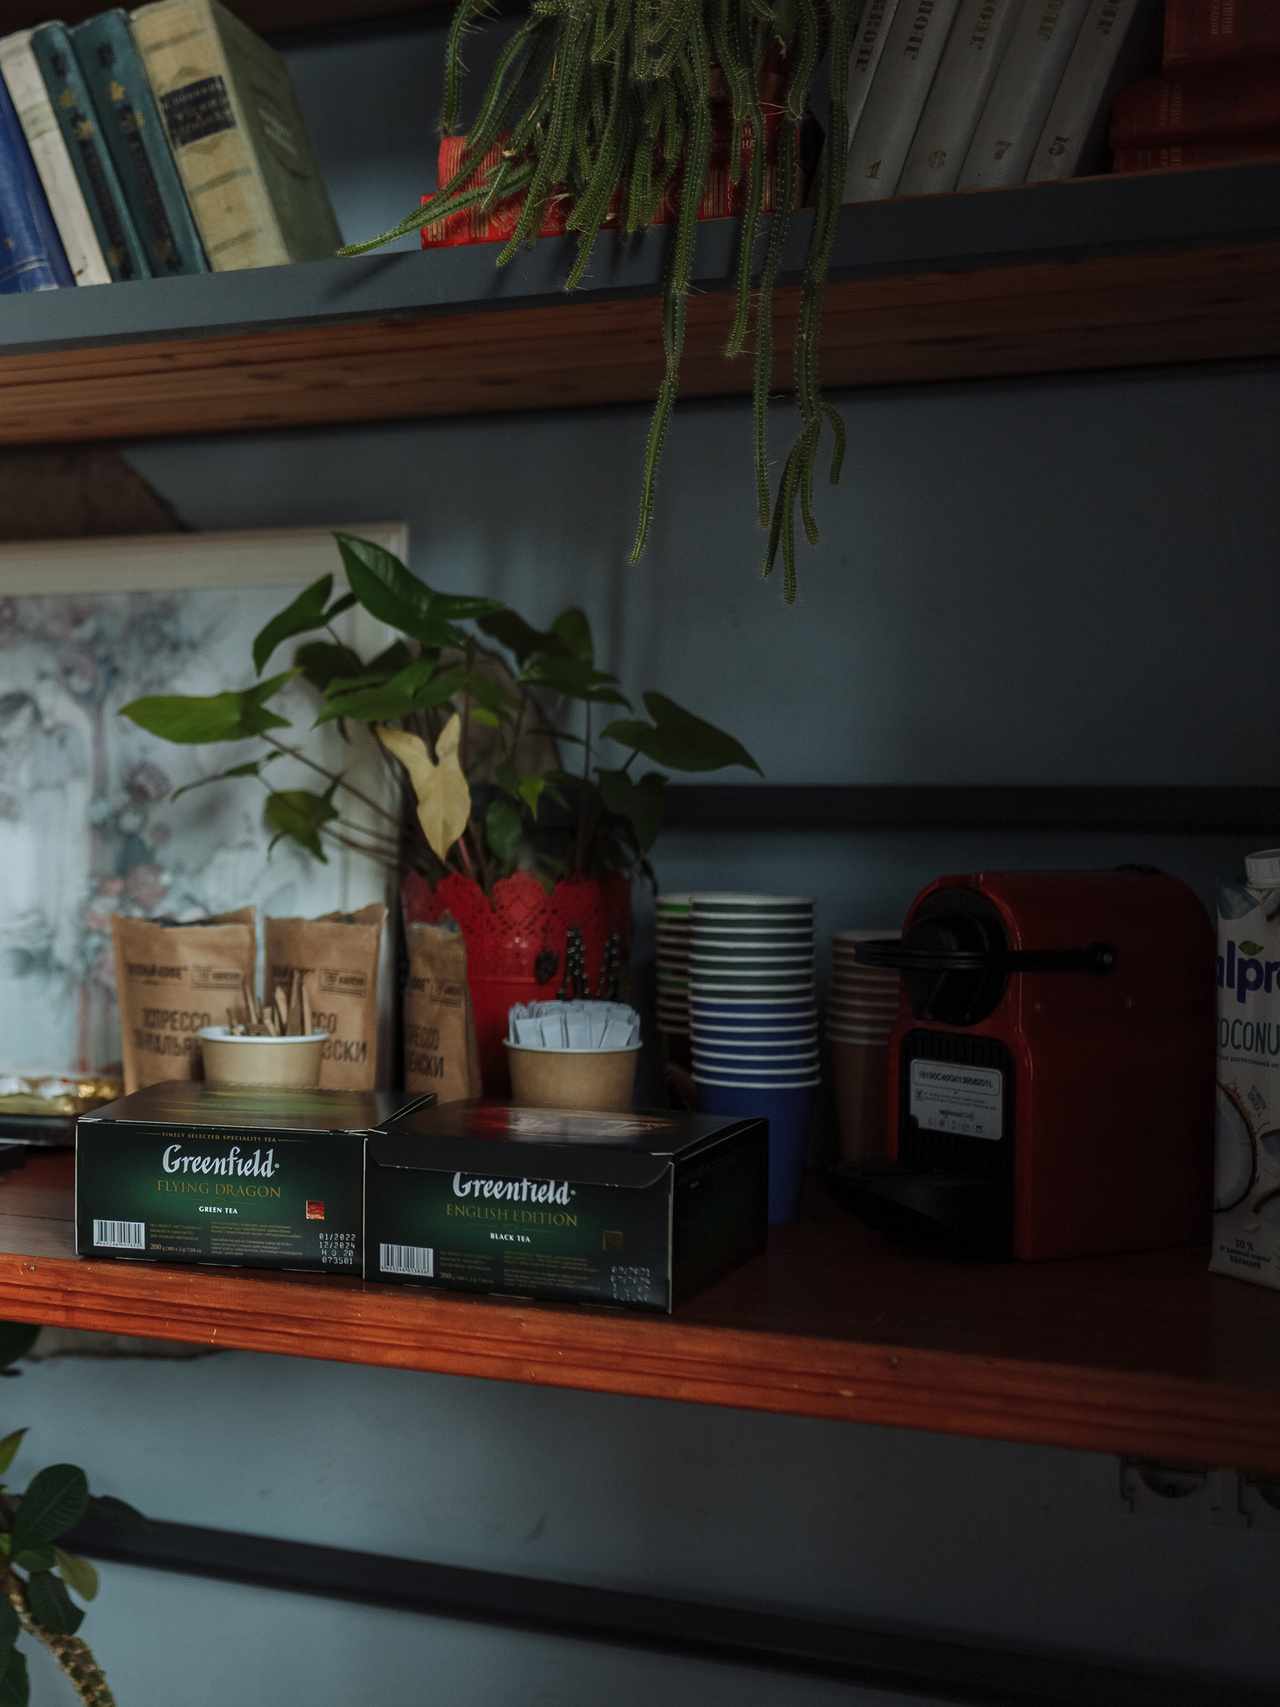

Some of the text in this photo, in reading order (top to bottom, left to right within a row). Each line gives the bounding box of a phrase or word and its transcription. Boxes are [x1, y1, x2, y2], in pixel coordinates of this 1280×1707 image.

[995, 140, 1013, 160] 7
[1049, 136, 1070, 156] 5
[1217, 940, 1280, 1004] lpr
[1218, 1018, 1280, 1056] OCONU
[223, 1135, 261, 1143] SPECIALITY
[162, 1144, 276, 1178] Greenfield
[157, 1180, 281, 1198] FLYING DRAGON
[452, 1171, 572, 1206] Greenfield
[199, 1205, 222, 1214] GREEN
[446, 1203, 578, 1227] ENGLISH EDITION
[319, 1232, 356, 1241] 01/2022
[319, 1241, 355, 1249] 12/2024
[490, 1232, 531, 1243] BLACK TEA
[322, 1256, 353, 1265] 073501
